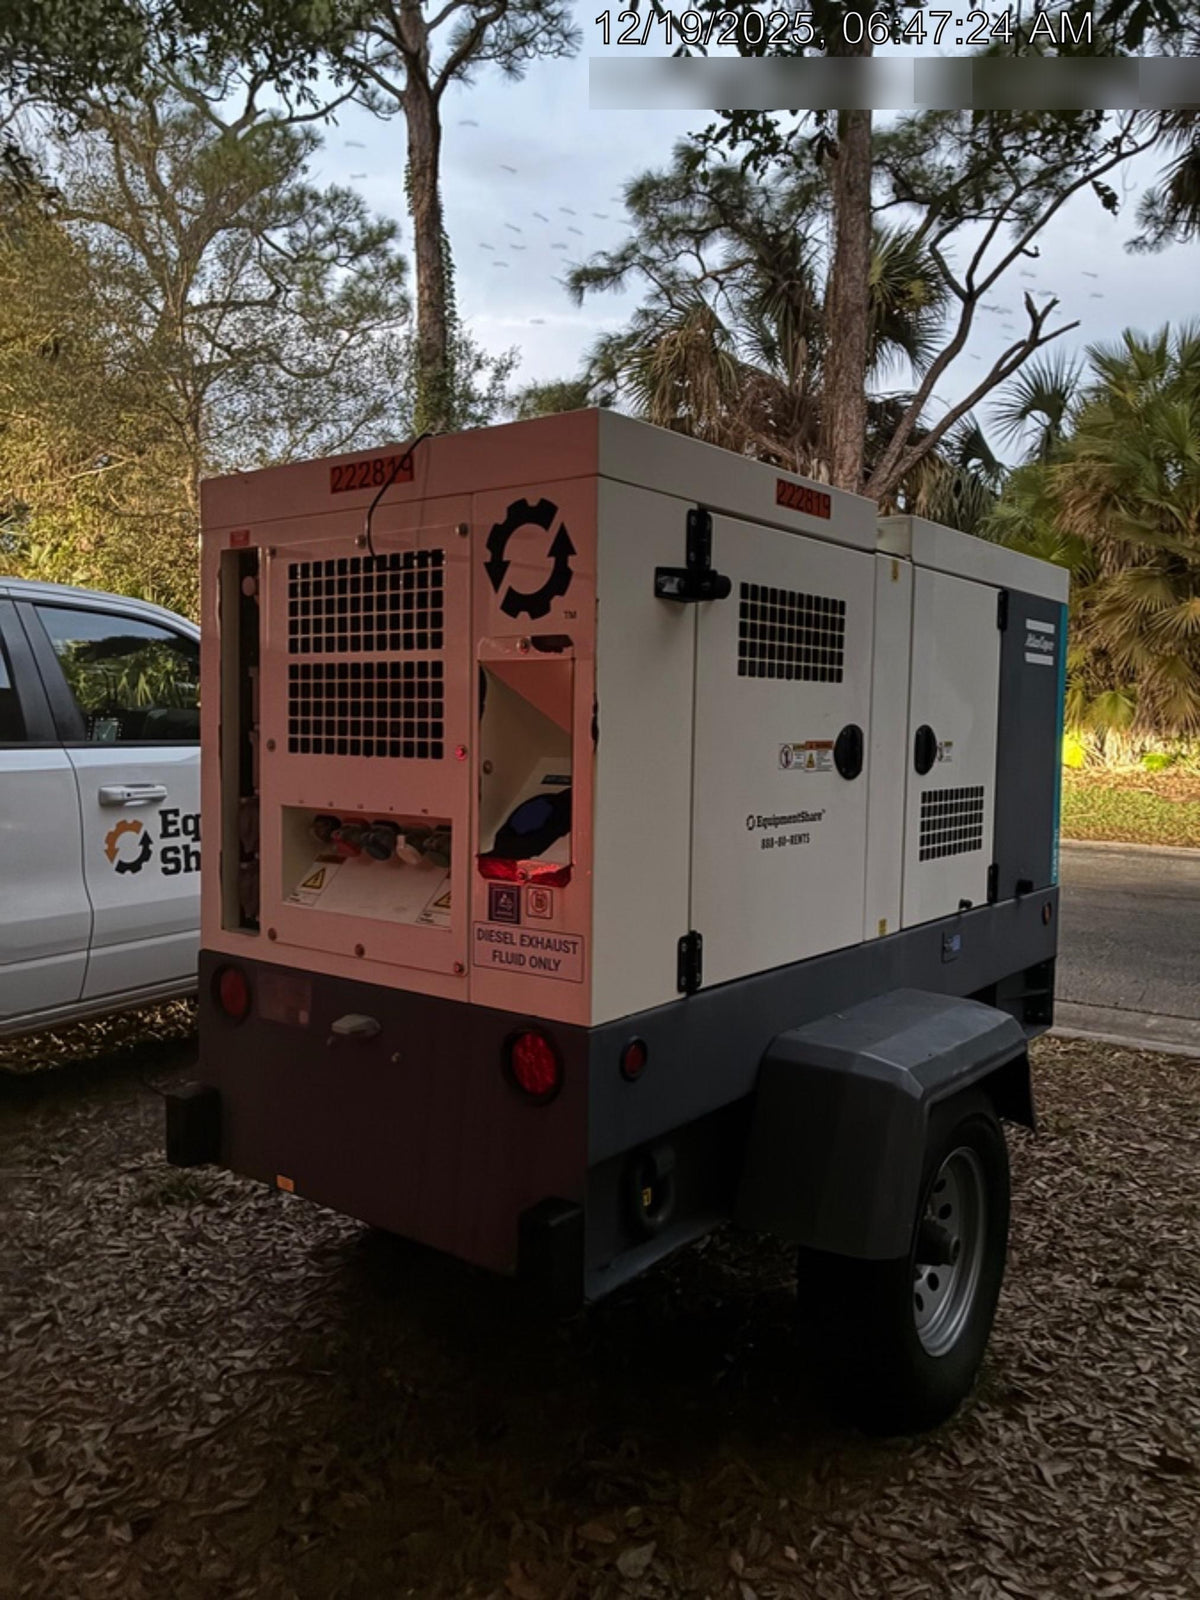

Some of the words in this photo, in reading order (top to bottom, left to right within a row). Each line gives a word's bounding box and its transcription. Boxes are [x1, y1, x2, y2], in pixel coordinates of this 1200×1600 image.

[477, 927, 517, 946] DIESEL
[520, 934, 579, 955] EXHAUST
[492, 949, 526, 967] FLUID
[529, 955, 562, 972] ONLY
